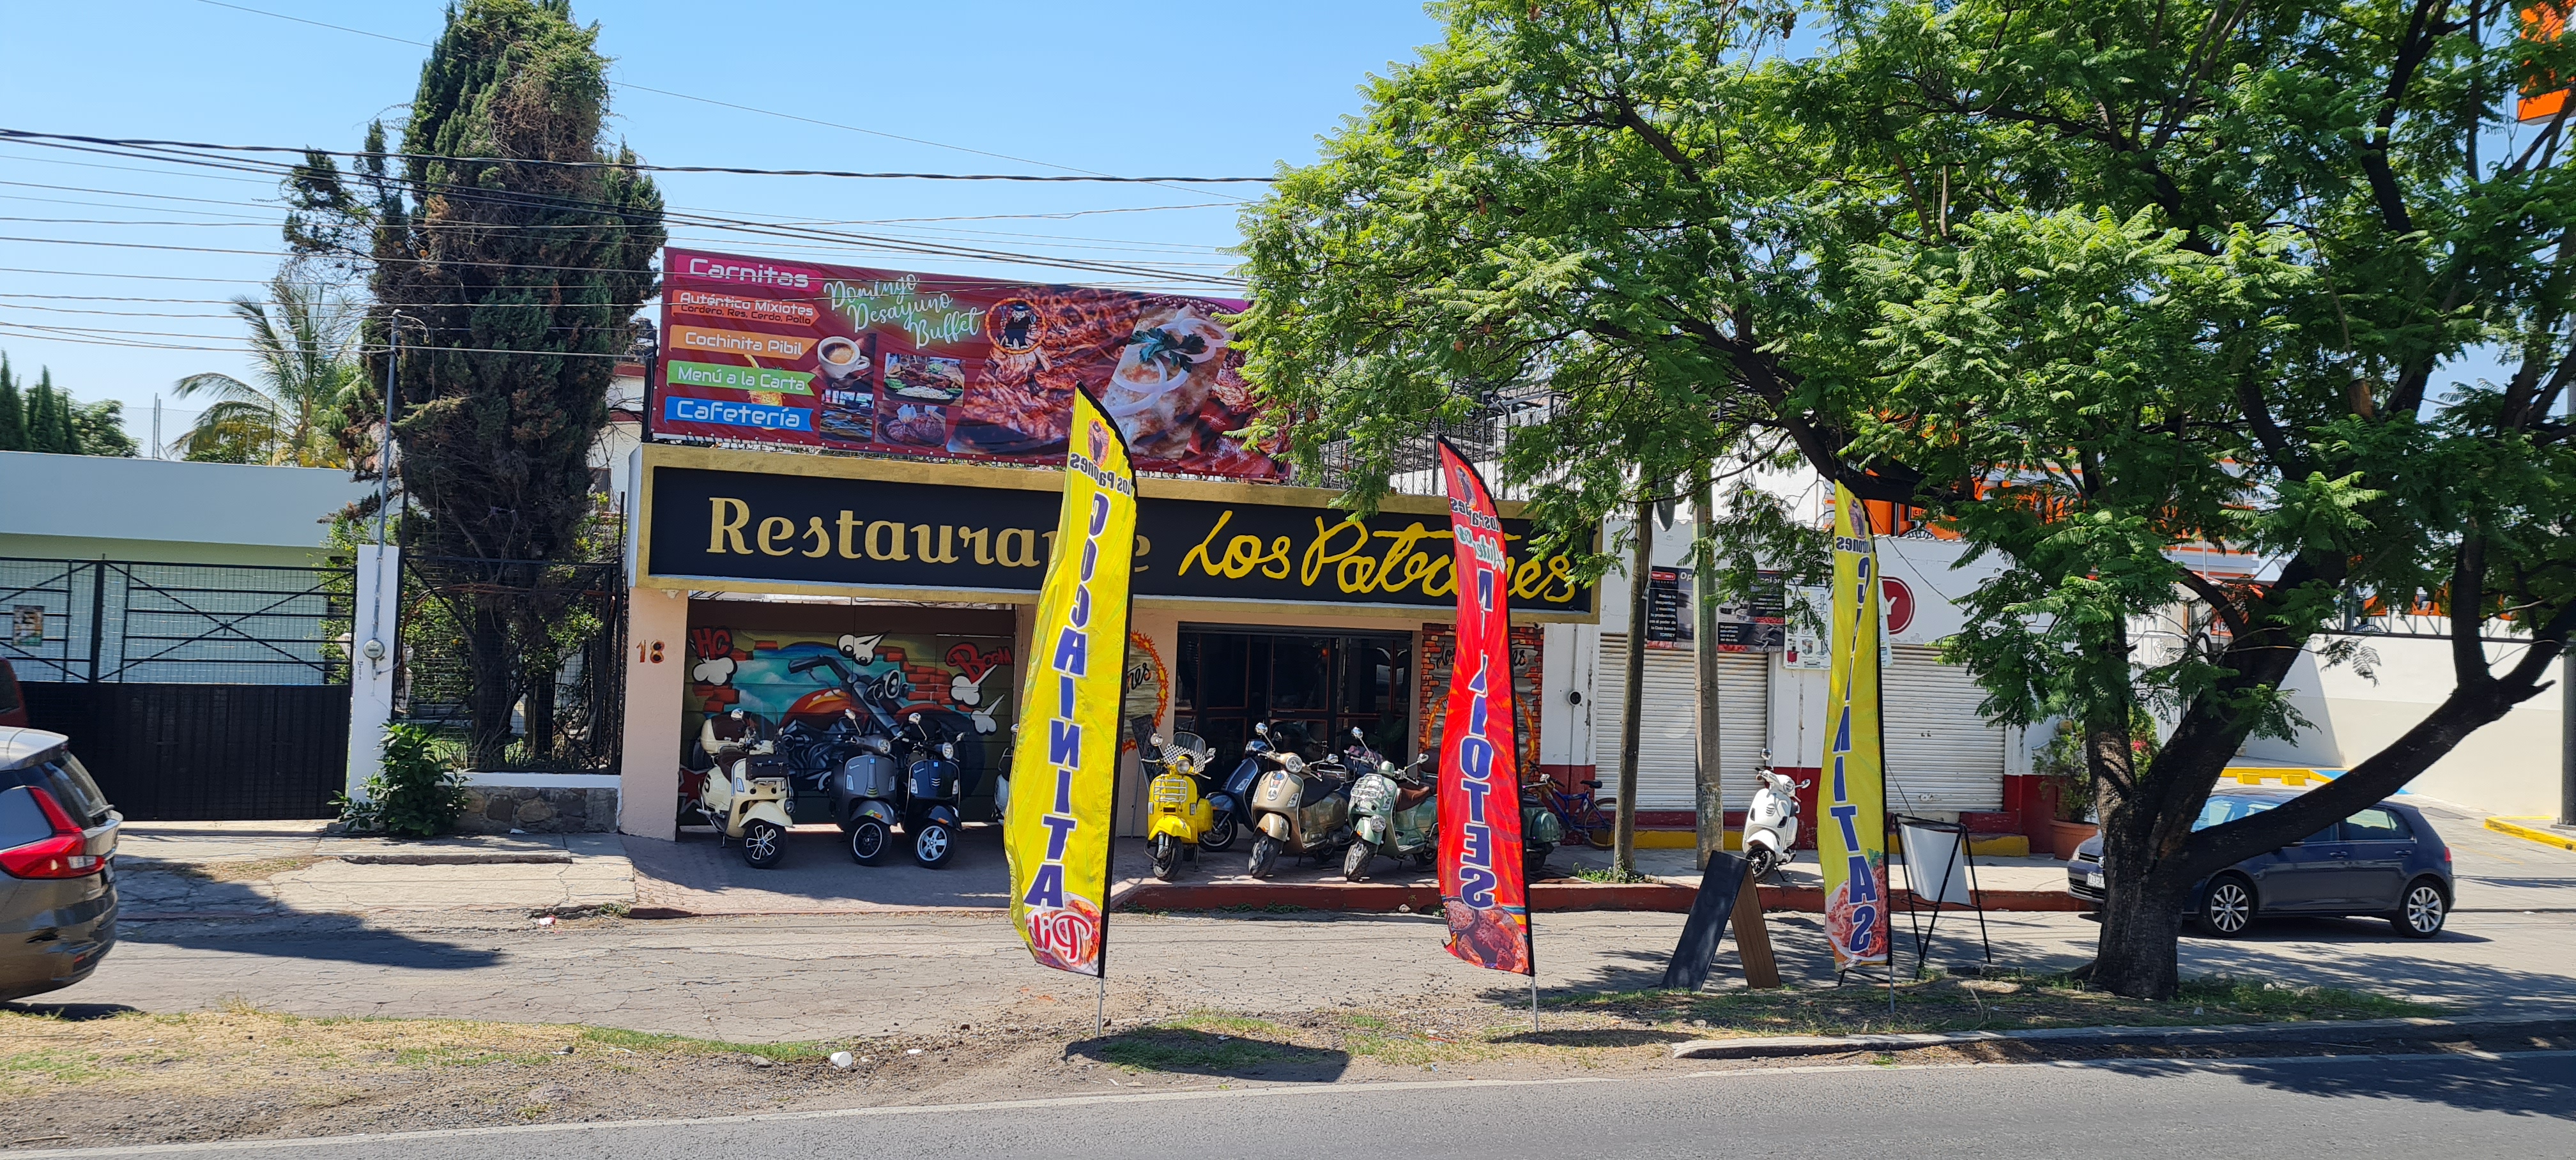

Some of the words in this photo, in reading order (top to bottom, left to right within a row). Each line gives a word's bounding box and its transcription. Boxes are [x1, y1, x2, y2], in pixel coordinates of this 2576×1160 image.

[689, 258, 809, 287] Carnitas
[680, 293, 751, 309] Auténtico
[755, 300, 813, 316] Mixiotes
[824, 273, 919, 310] Domingo
[681, 305, 724, 317] Cordero,
[728, 309, 748, 318] Res,
[751, 312, 783, 322] Cerdo,
[786, 316, 811, 324] Pollo
[847, 293, 953, 333] Desayuno
[908, 307, 985, 349] Buffet
[685, 332, 762, 351] Cochinita
[768, 340, 802, 355] Pibil
[678, 367, 722, 383] Menú
[726, 374, 736, 384] a
[742, 371, 755, 386] la
[760, 374, 805, 390] Carta
[677, 401, 799, 427] Cafetería
[706, 496, 1151, 573] Restaura
[1178, 510, 1291, 579] Los
[1301, 515, 1576, 603] Patroes
[636, 639, 665, 664] 18
